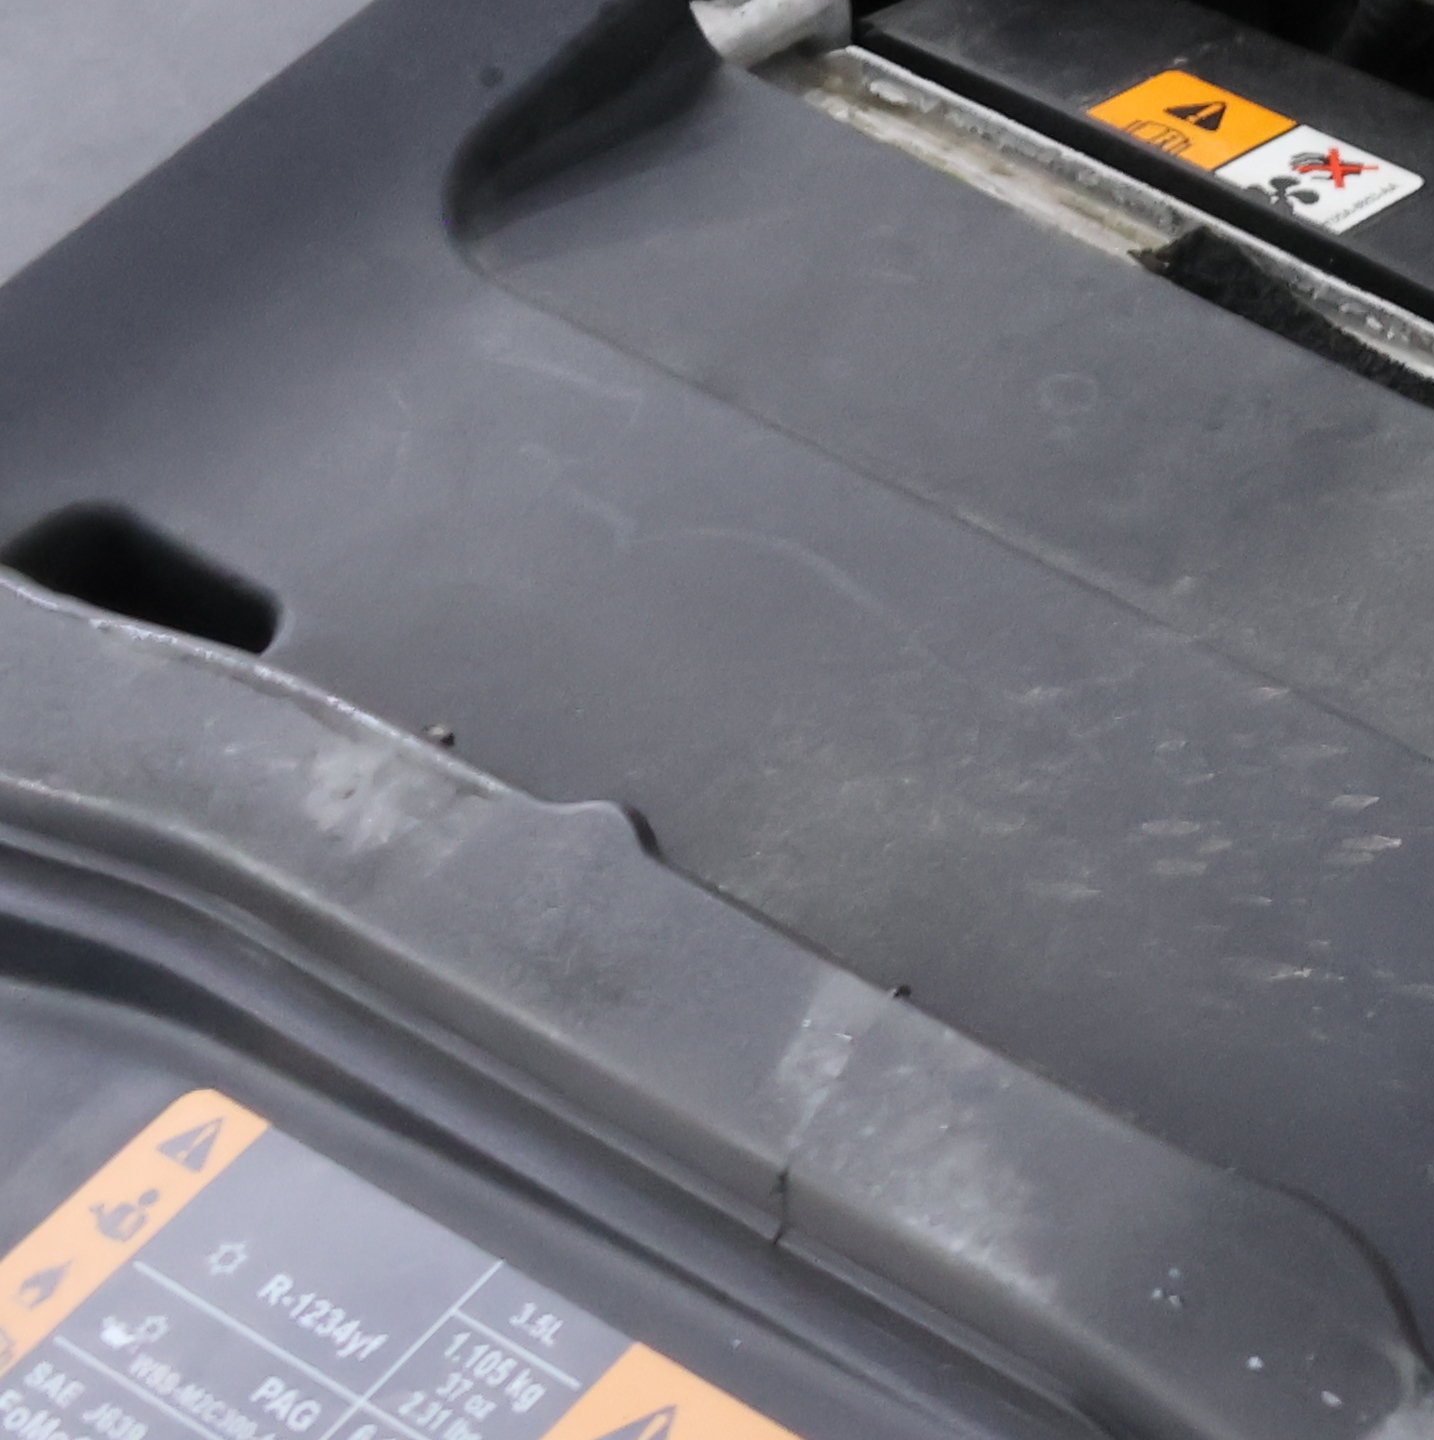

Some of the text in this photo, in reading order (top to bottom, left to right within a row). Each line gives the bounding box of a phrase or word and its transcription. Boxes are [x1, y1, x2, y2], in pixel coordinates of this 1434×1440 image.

[255, 1273, 390, 1362] R-1234yf
[23, 1359, 85, 1409] SAE
[435, 1371, 475, 1402] 37
[443, 1330, 548, 1413] 1.105 kg
[249, 1375, 322, 1433] PAG
